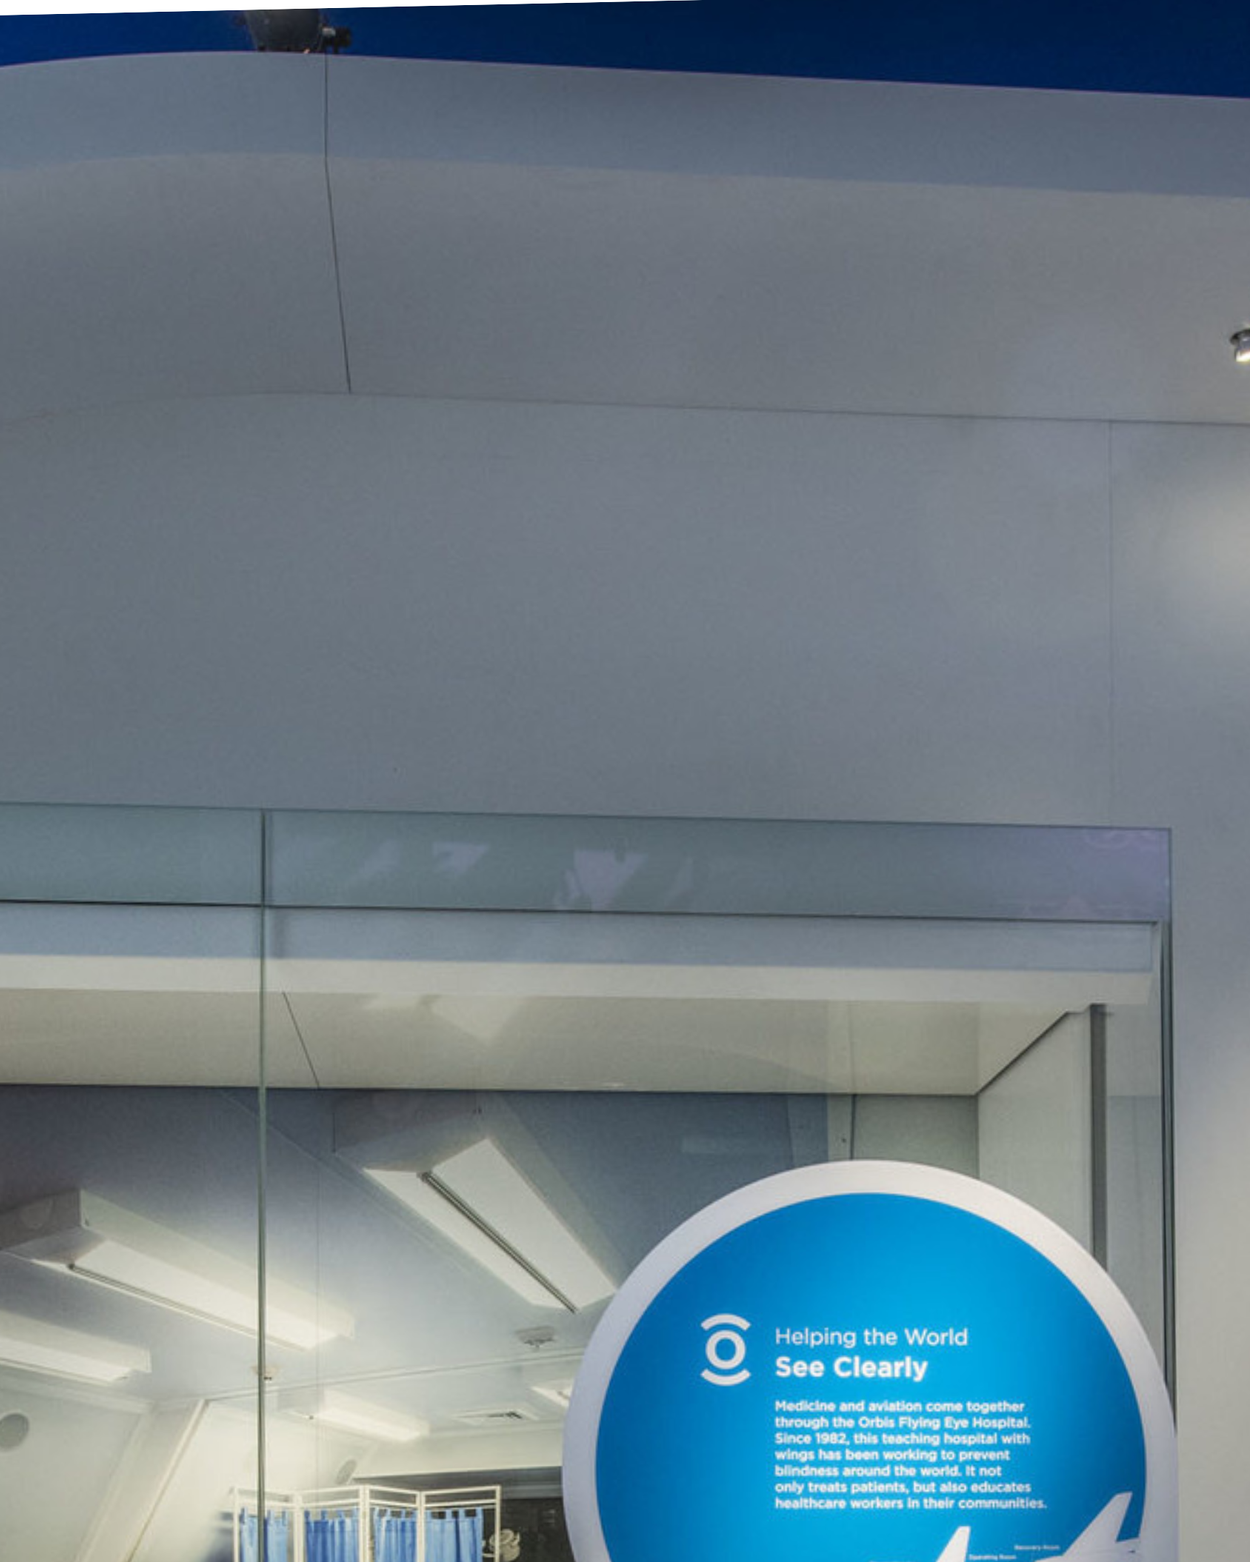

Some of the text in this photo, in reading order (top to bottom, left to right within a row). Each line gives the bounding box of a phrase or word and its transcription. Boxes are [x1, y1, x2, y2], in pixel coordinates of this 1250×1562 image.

[775, 1327, 968, 1349] Helping the World
[775, 1355, 928, 1382] See Clearly
[775, 1401, 1025, 1414] Medicine and aviation come together
[775, 1417, 1030, 1431] through the Orbis Flying Eye Hospital.
[775, 1433, 1030, 1447] Since 1982, this teaching hospital with
[775, 1449, 1010, 1463] wings has been working to prevent
[774, 1465, 1002, 1476] blindness around the world. It not
[775, 1482, 1031, 1495] only treats patients, but also educates
[775, 1498, 1046, 1509] healthcare workers in their communities.
